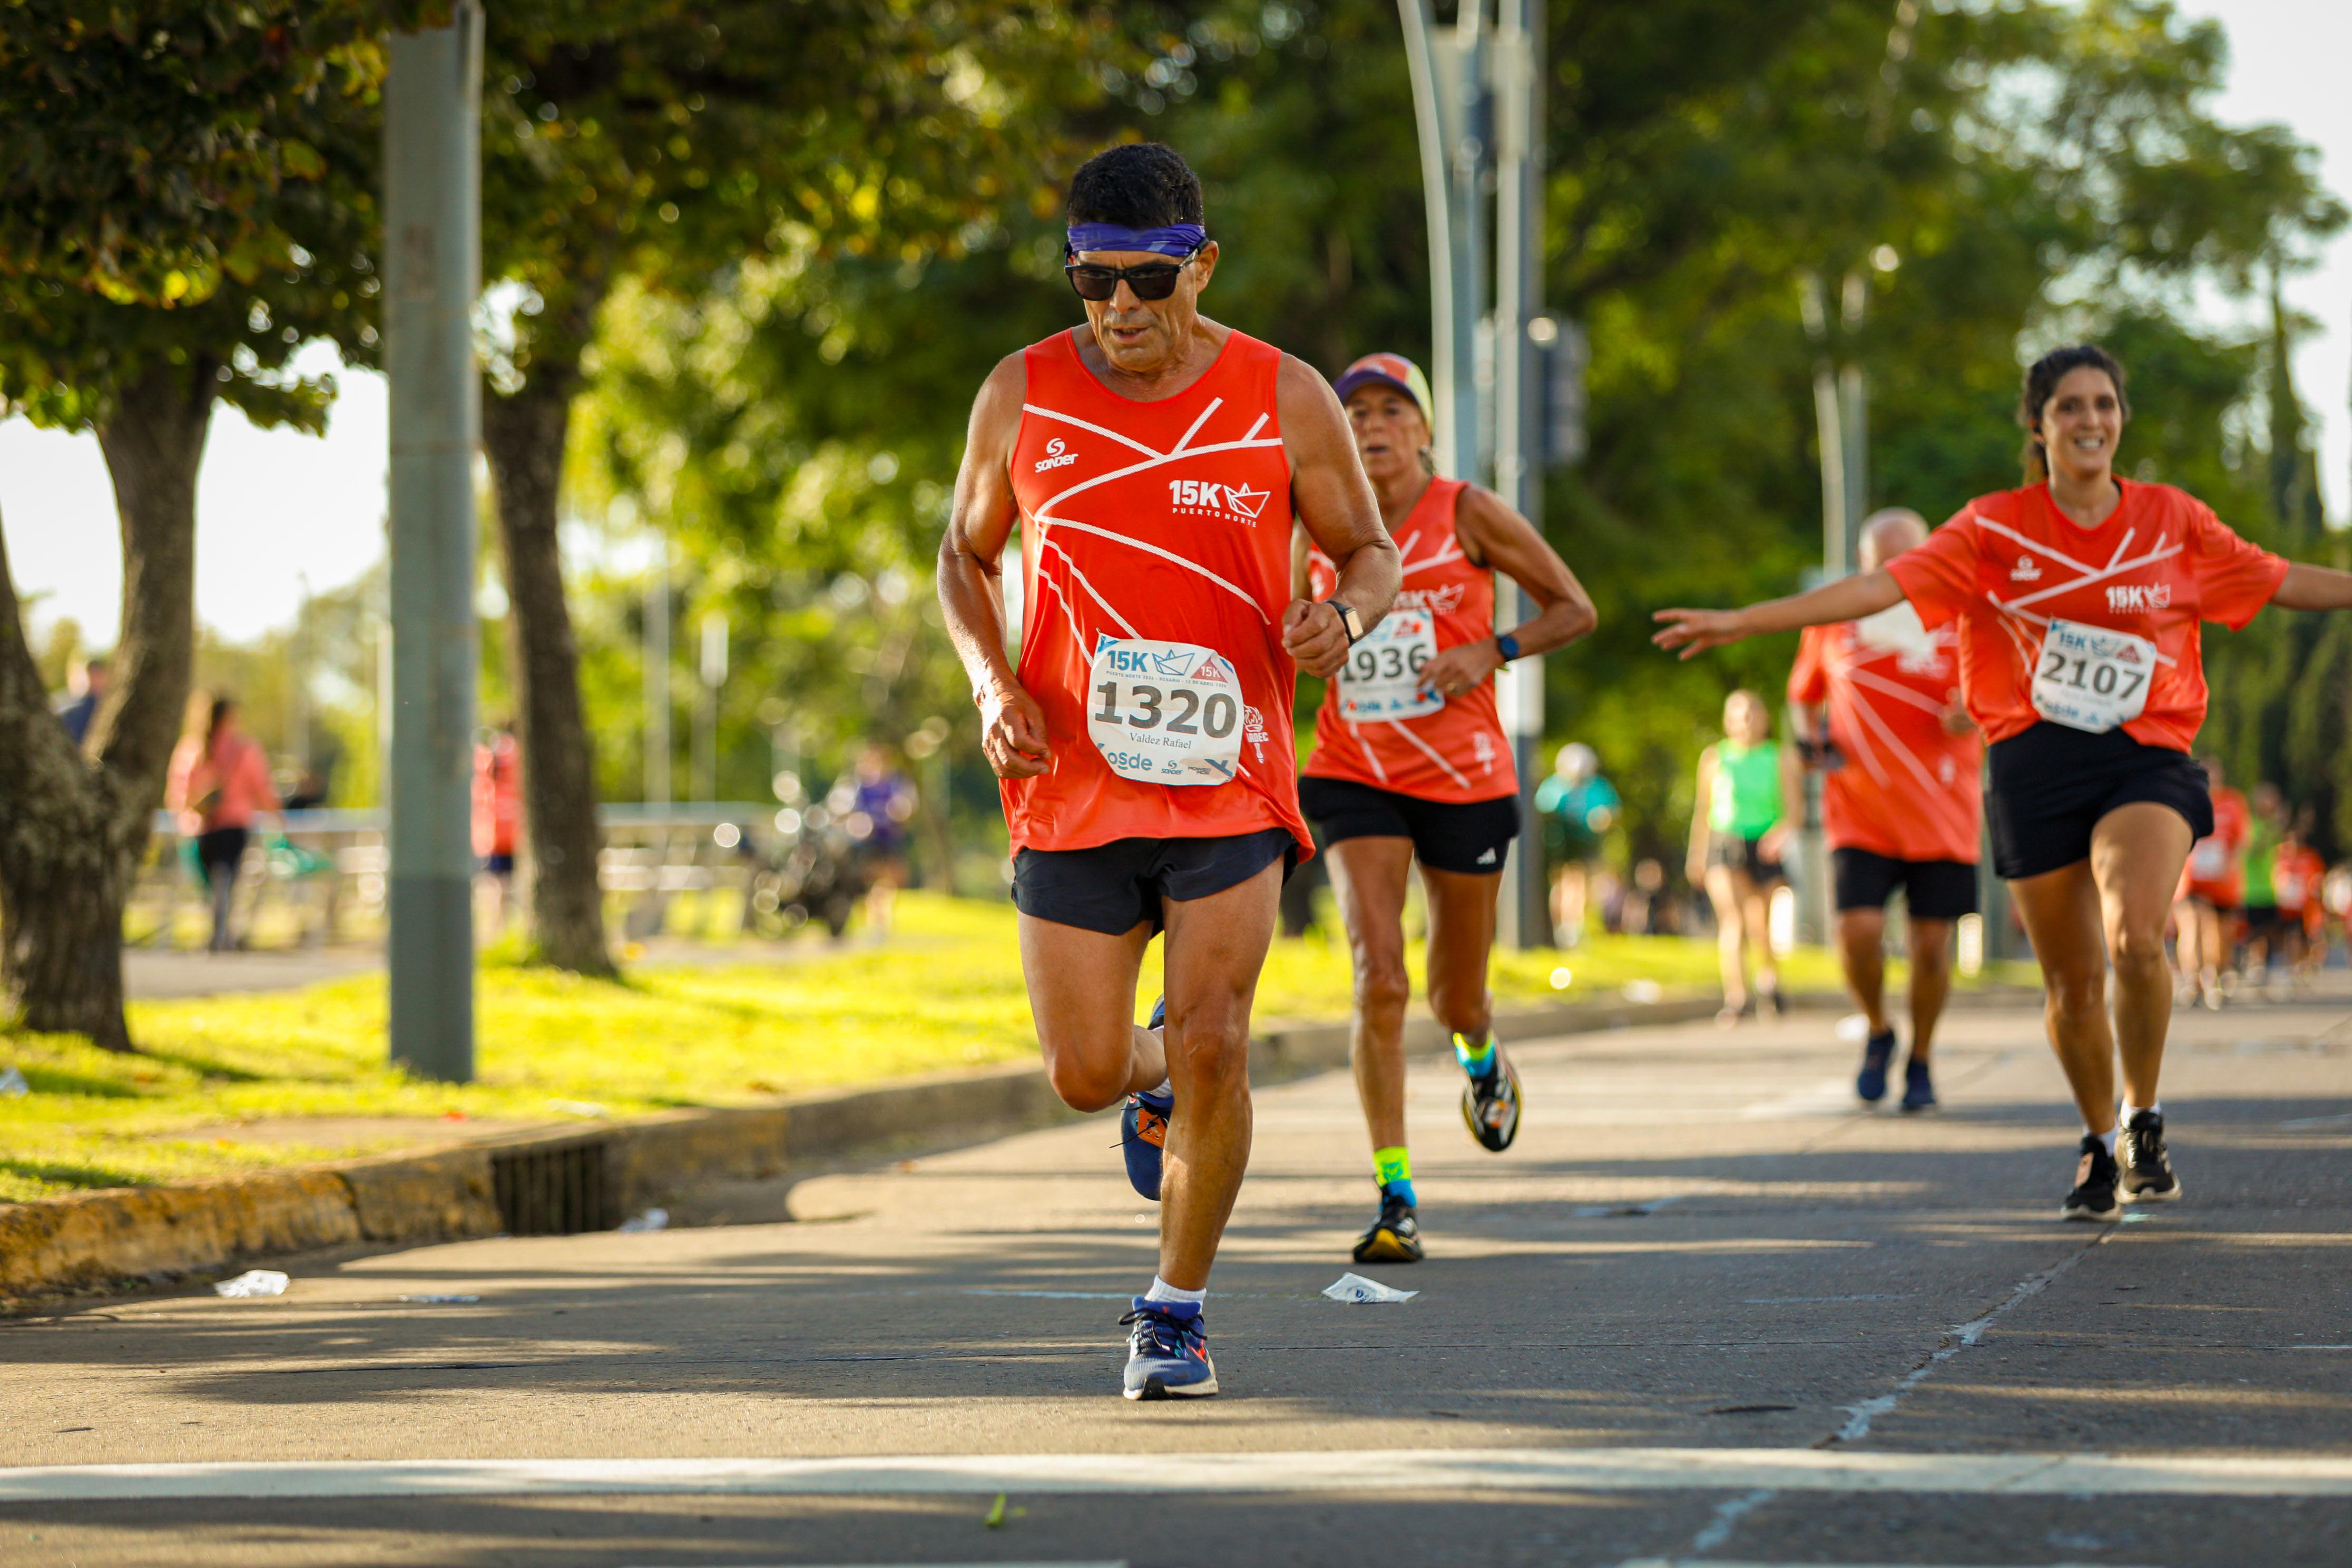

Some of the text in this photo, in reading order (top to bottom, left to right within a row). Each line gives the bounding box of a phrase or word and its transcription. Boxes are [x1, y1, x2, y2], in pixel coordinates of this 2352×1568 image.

[1169, 479, 1222, 508] 15K
[1172, 507, 1257, 527] PUERTO NORTE
[2105, 585, 2144, 609] 15K
[1107, 650, 1149, 672] 15K
[1201, 665, 1221, 678] 15K
[2041, 650, 2145, 700] 2107
[1095, 681, 1237, 739] 1320
[1130, 732, 1192, 749] Valdez Rafael
[1108, 752, 1153, 771] osde
